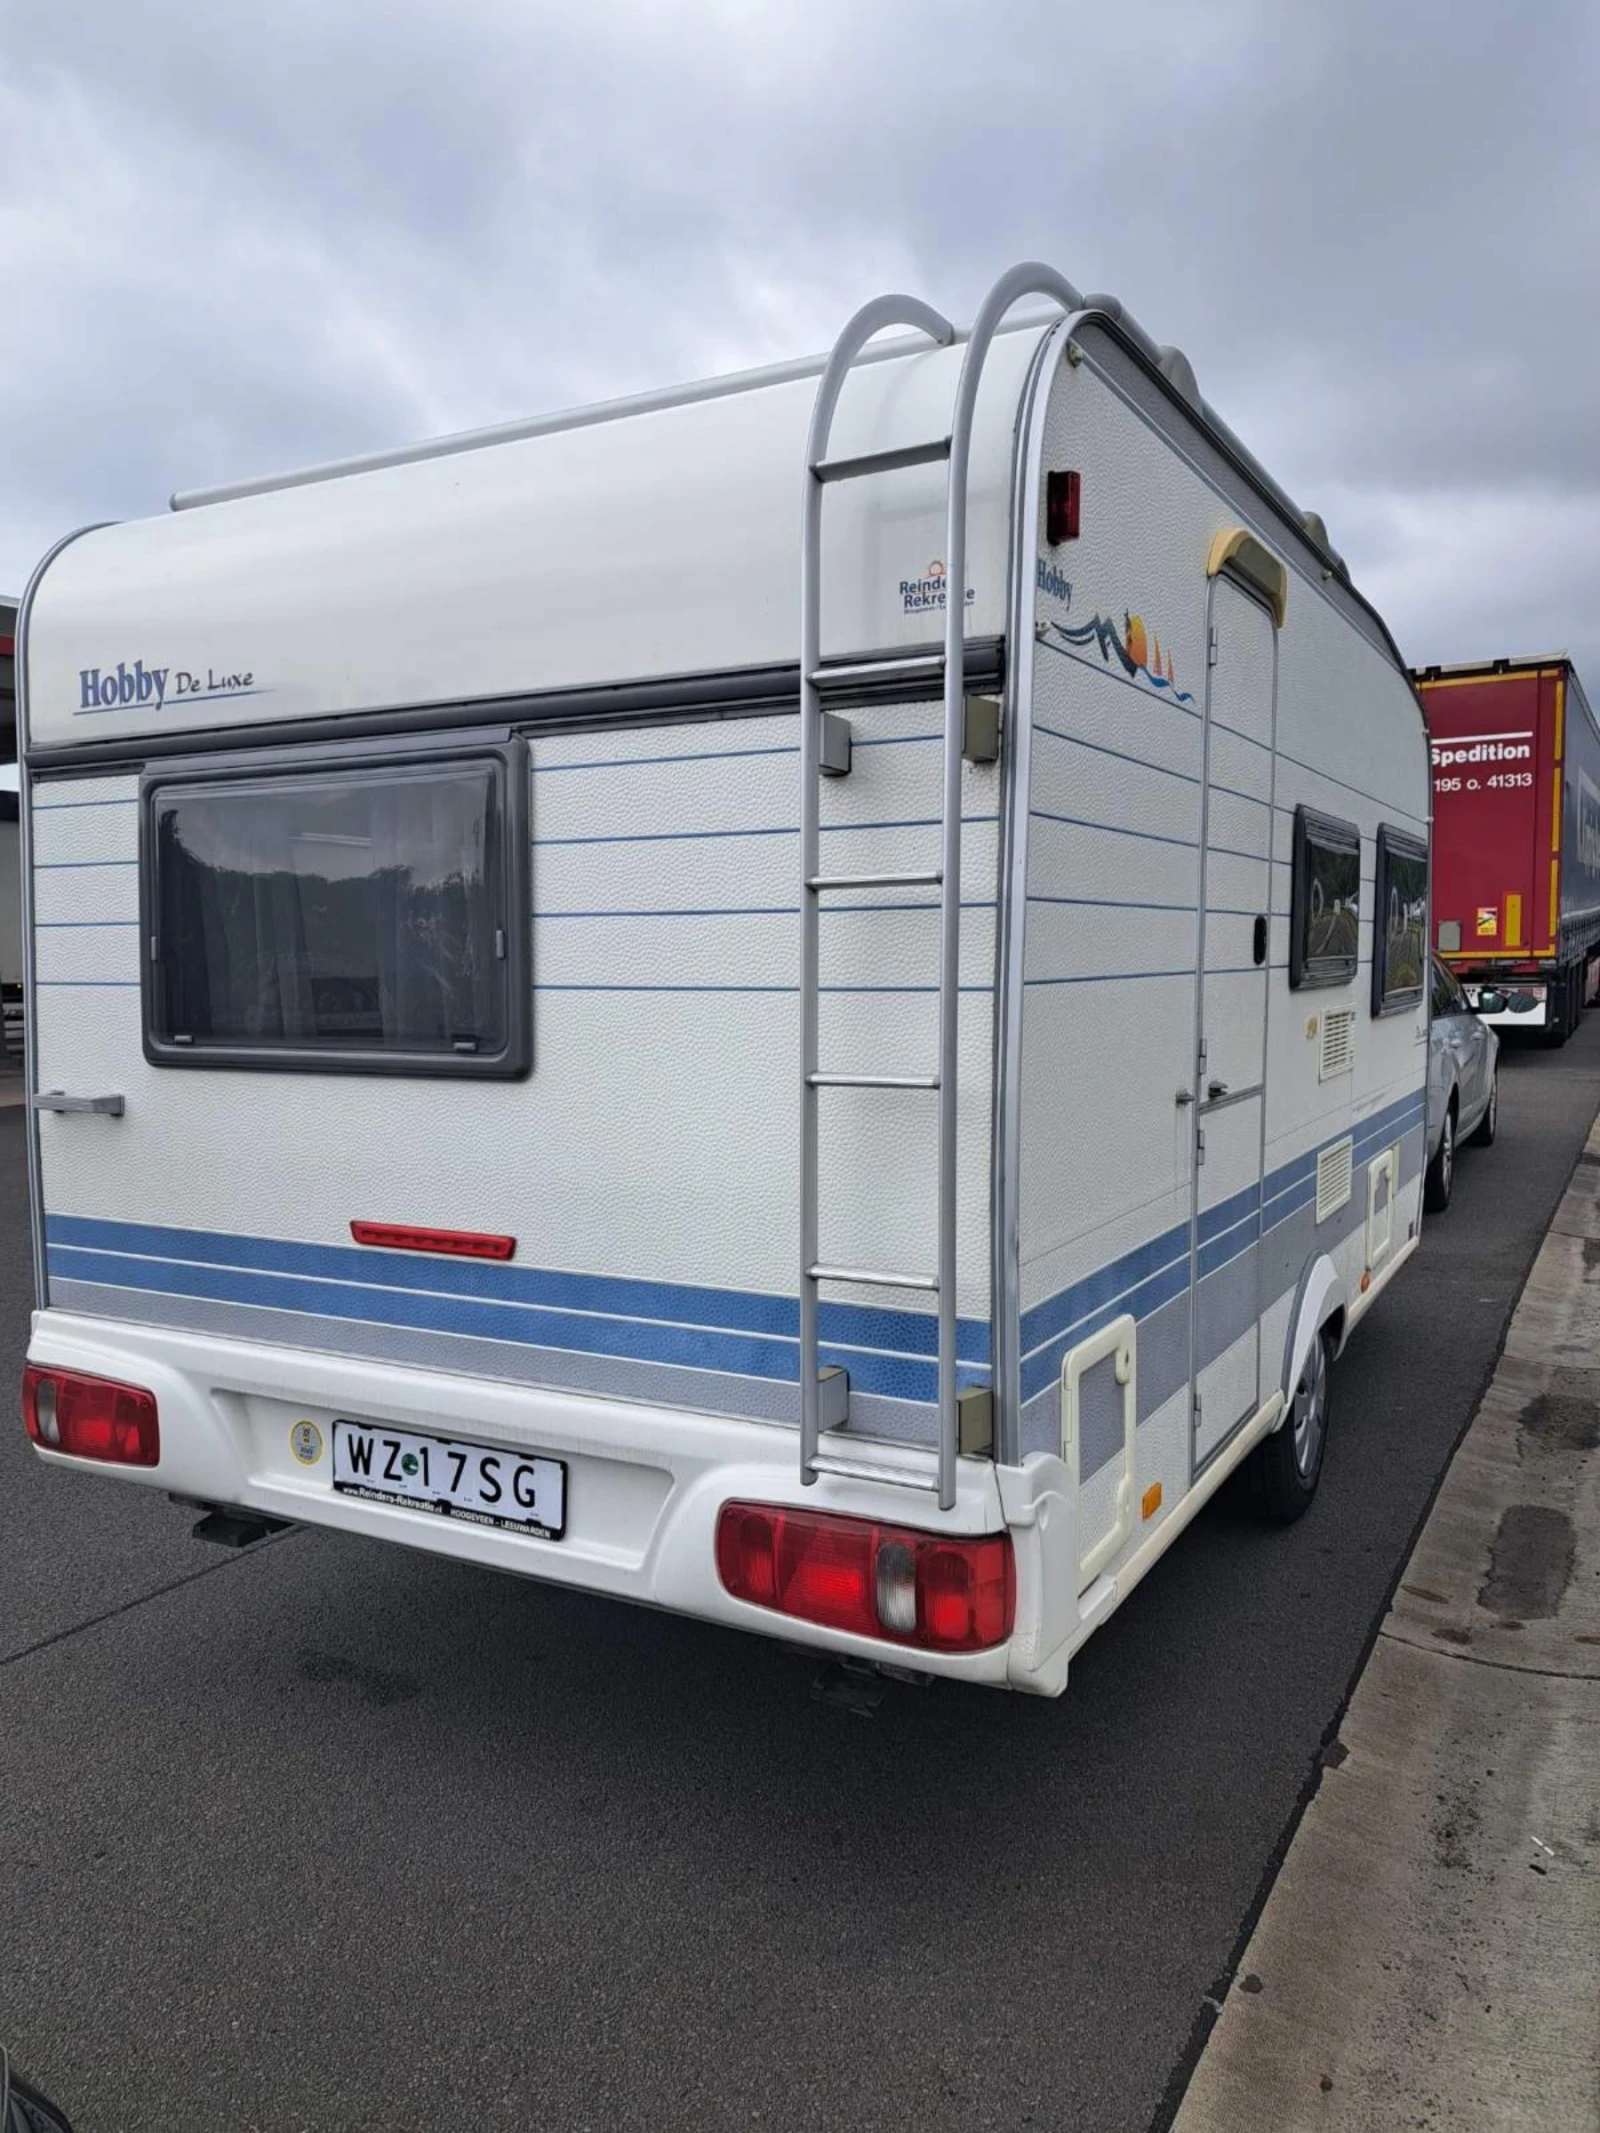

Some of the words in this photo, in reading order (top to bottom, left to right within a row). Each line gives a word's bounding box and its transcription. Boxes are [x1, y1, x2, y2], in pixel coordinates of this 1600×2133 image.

[1037, 559, 1073, 611] Hobby
[904, 588, 976, 608] Rekree
[80, 660, 169, 710] Hobby
[174, 672, 201, 694] De
[207, 669, 254, 690] Luxe
[1431, 743, 1531, 767] Spedition
[1487, 772, 1533, 788] 41313
[501, 1519, 551, 1539] LEEUWARDEN
